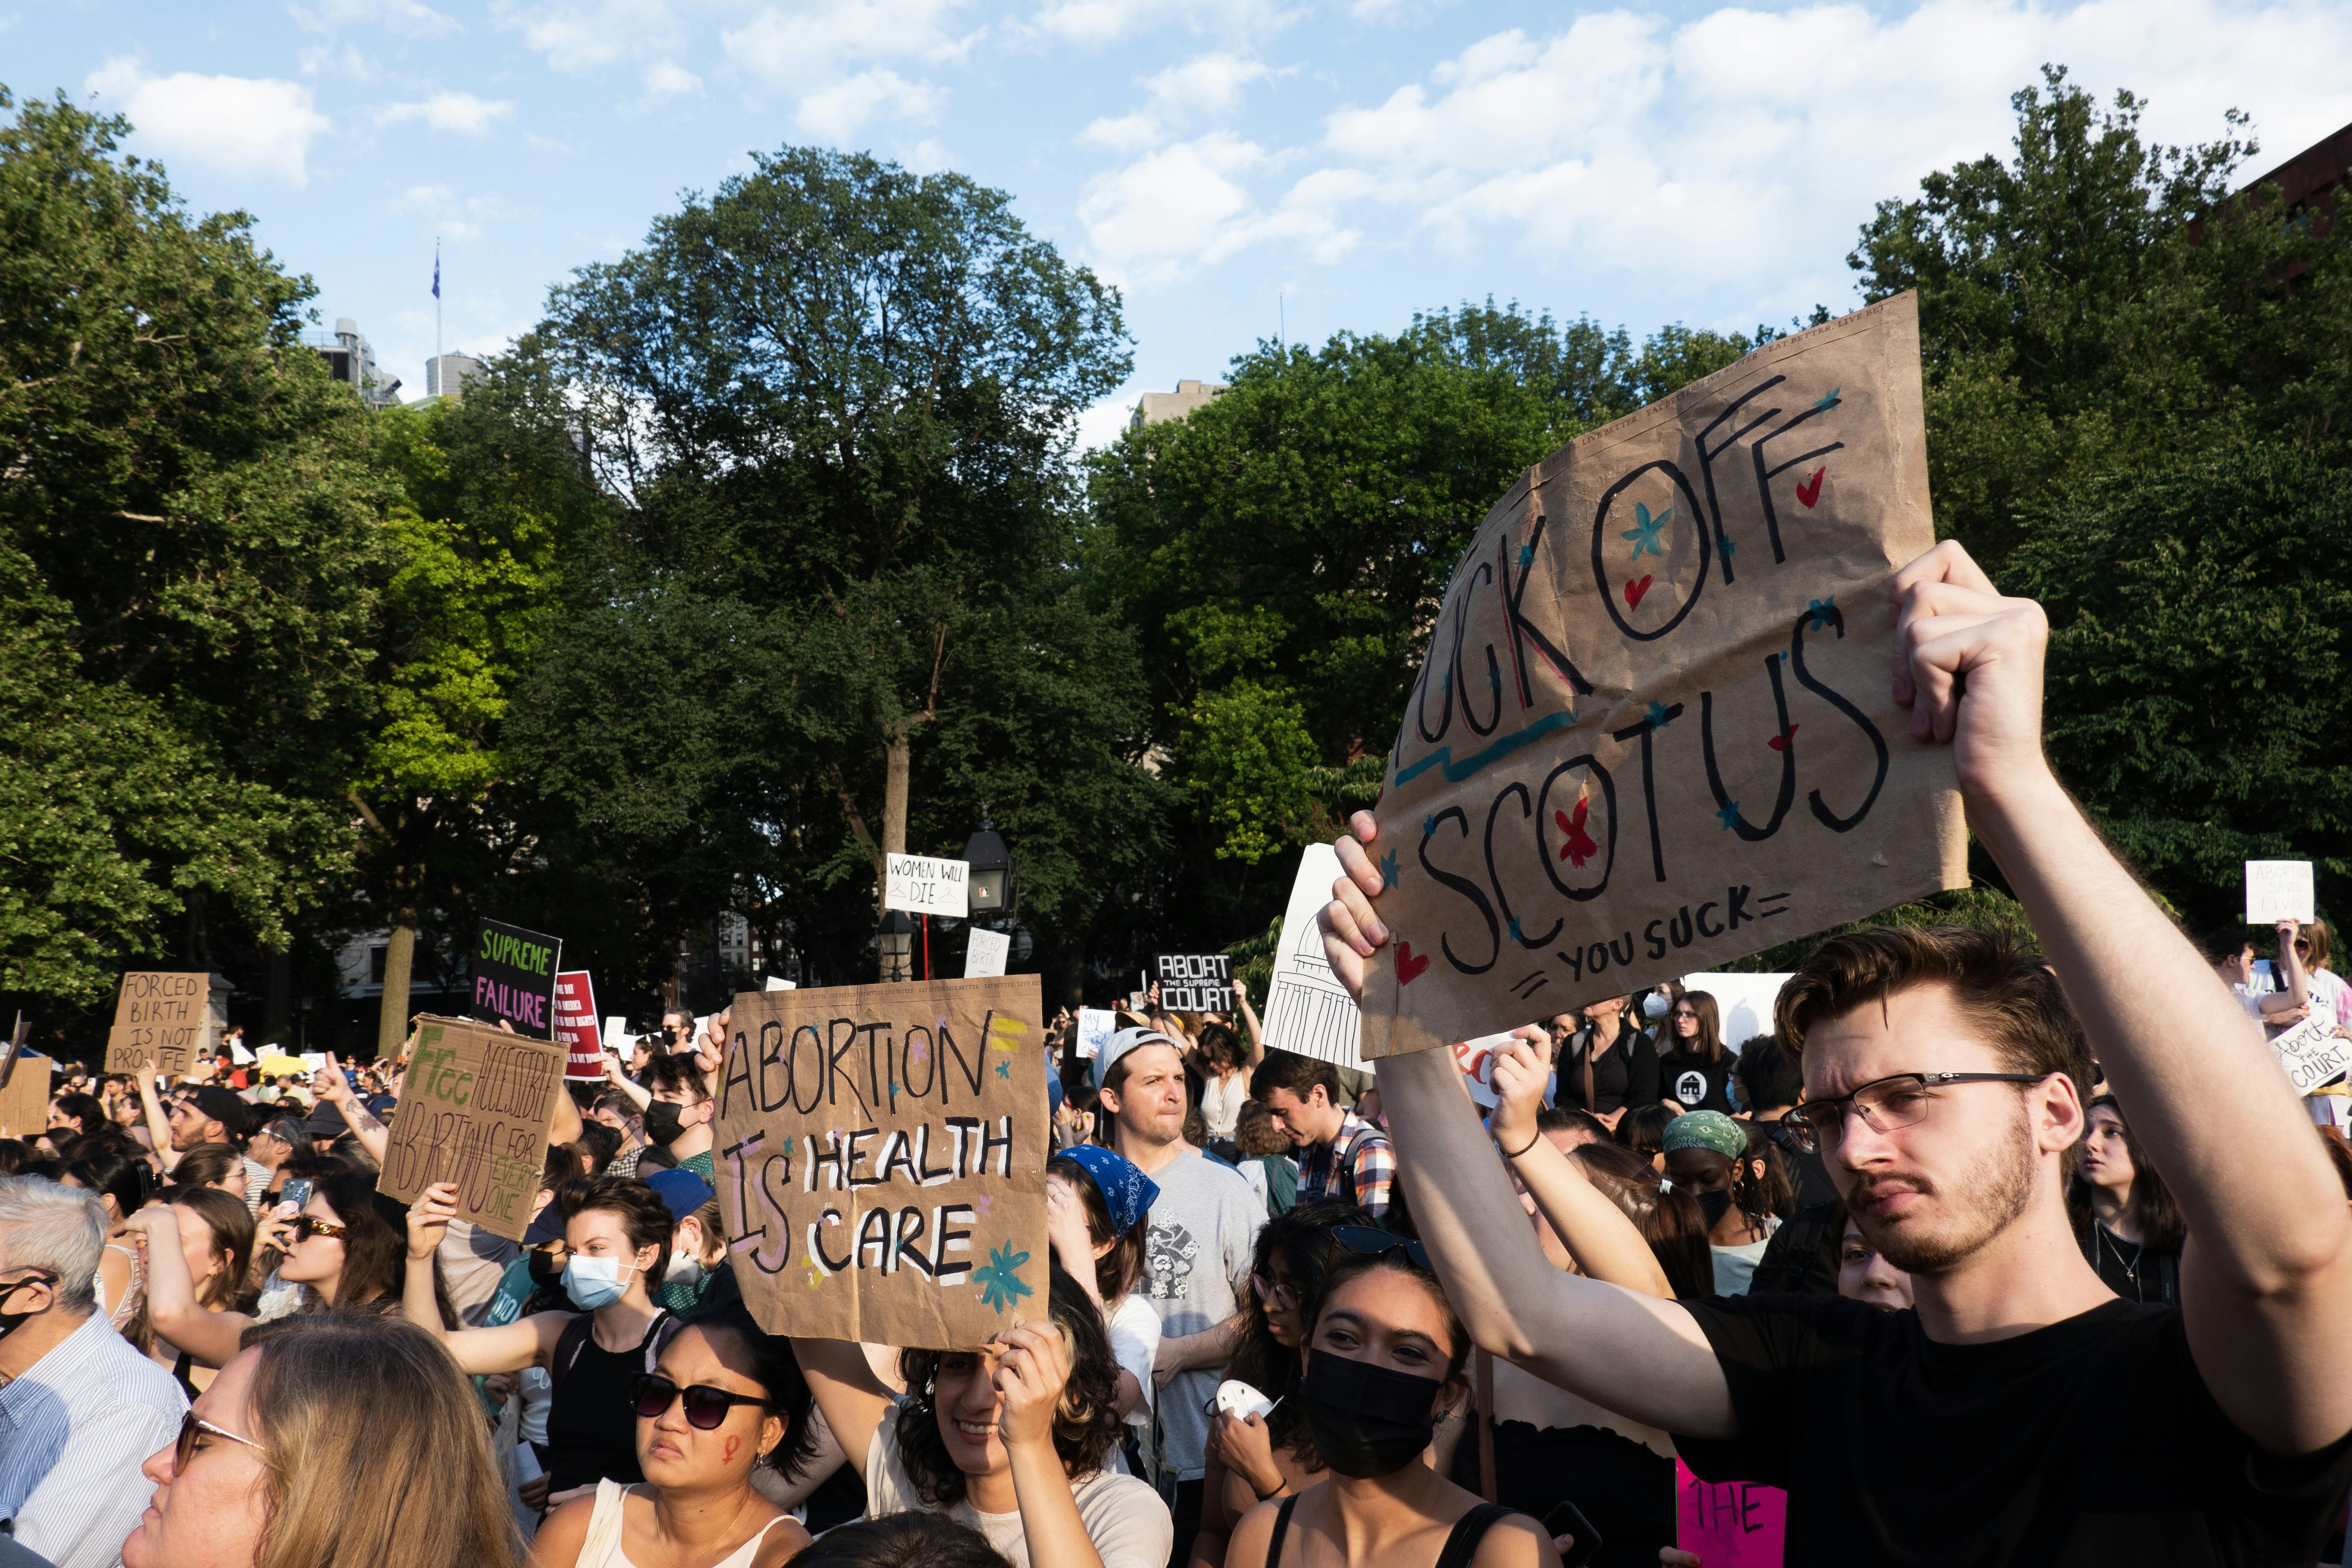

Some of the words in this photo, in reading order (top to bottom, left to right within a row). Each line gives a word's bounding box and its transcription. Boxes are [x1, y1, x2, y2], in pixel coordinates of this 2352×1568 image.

[1582, 433, 1602, 446] LIVE
[1604, 416, 1637, 436] BETTER
[1647, 403, 1663, 417] EAT
[1701, 373, 1722, 386] LIVE
[1723, 352, 1758, 375] BETTER
[1768, 340, 1788, 353] EAT
[1838, 313, 1863, 328] LIVE
[1591, 374, 1845, 642] OFF
[1418, 606, 1890, 975] SCOTUS
[889, 856, 935, 879] WOMEN
[941, 864, 963, 882] WILL
[2255, 865, 2311, 881] ABORTION
[910, 882, 936, 904] DIE
[2269, 882, 2301, 894] SAVES
[2261, 897, 2302, 912] LIVES
[971, 931, 1001, 952] FORCED
[1556, 931, 1635, 983] YOU
[1643, 885, 1754, 961] SUCK
[480, 929, 552, 976] SUPREME
[970, 949, 996, 967] BIRTH
[1158, 955, 1230, 979] ABORT
[124, 974, 197, 998] FORCED
[1183, 978, 1221, 987] SUPREME
[130, 1001, 188, 1023] BIRTH
[476, 976, 546, 1029] FAILURE
[1161, 987, 1231, 1012] COURT
[576, 1015, 595, 1027] RIGHTS
[1083, 1027, 1106, 1039] BODY
[1084, 1013, 1100, 1030] MY
[130, 1027, 153, 1047] IS
[160, 1027, 196, 1046] NOT
[2274, 1019, 2332, 1064] Abort
[721, 1009, 995, 1123] ABORTION
[2299, 1047, 2319, 1063] THE
[406, 1025, 474, 1107] Free
[469, 1039, 560, 1123] ACCESSIBLE
[383, 1099, 506, 1214] ABORTIONS
[506, 1128, 537, 1165] FOR
[491, 1157, 537, 1192] EVERY
[486, 1185, 520, 1221] ONE
[722, 1129, 791, 1275] IS
[805, 1114, 1014, 1193] HEALTH
[809, 1203, 976, 1285] CARE
[1688, 1477, 1770, 1534] THE
